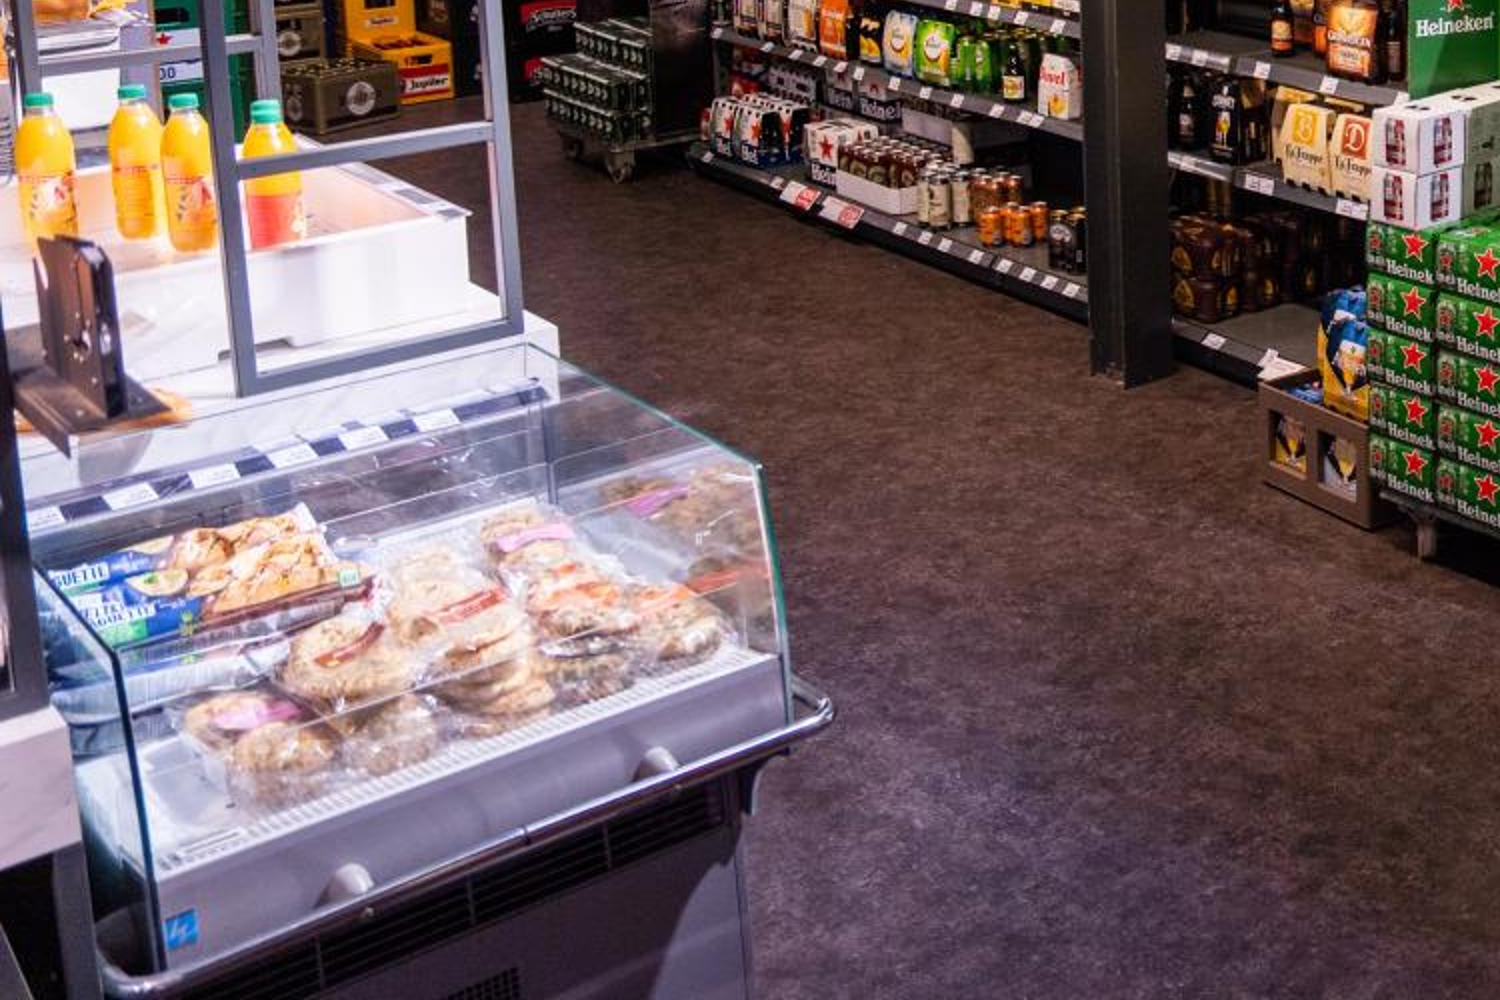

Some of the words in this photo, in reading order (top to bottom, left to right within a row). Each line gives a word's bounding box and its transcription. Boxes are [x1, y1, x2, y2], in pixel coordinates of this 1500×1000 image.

[1415, 14, 1494, 38] Heineken
[1386, 259, 1434, 285] Heinek
[1385, 316, 1432, 342] Heinek
[1385, 367, 1431, 395] Heinek
[1387, 422, 1435, 450] Heinek
[1387, 473, 1433, 501] Heinek
